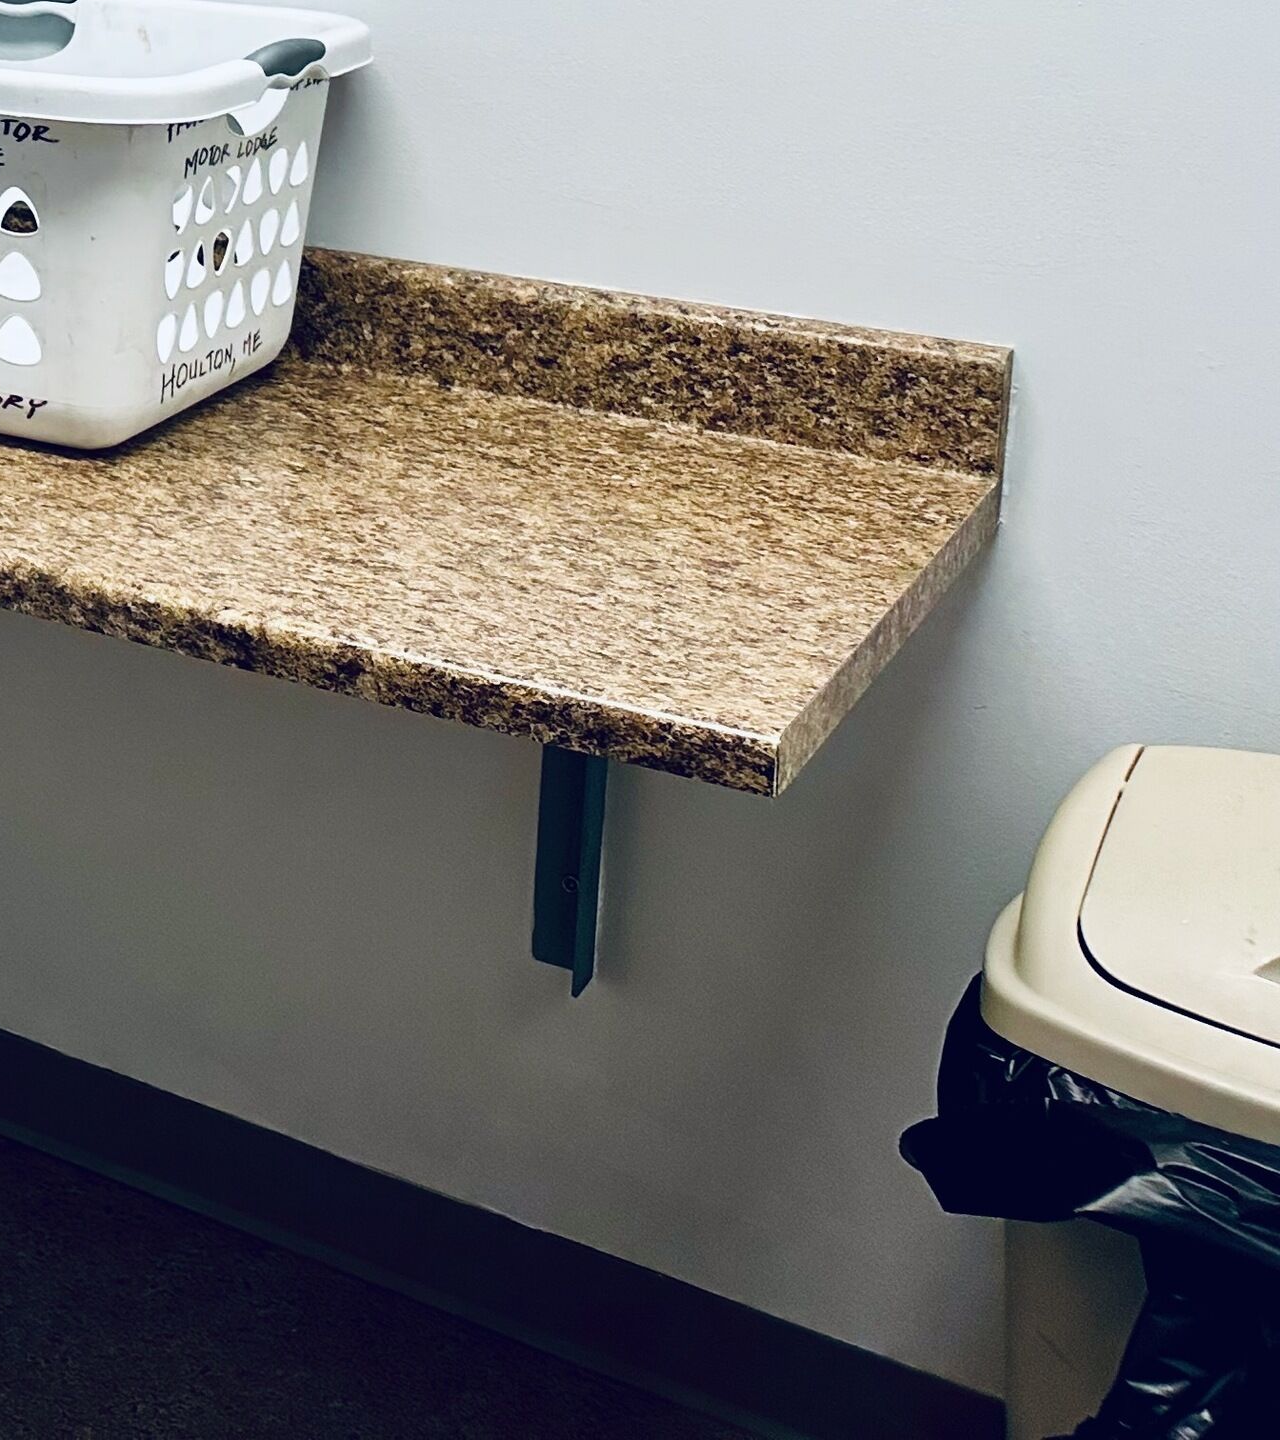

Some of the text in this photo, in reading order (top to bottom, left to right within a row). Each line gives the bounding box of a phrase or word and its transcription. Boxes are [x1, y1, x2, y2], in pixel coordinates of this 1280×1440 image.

[184, 143, 230, 179] MOTOR
[237, 126, 279, 159] LODGE
[160, 327, 263, 404] HOULTON, ME
